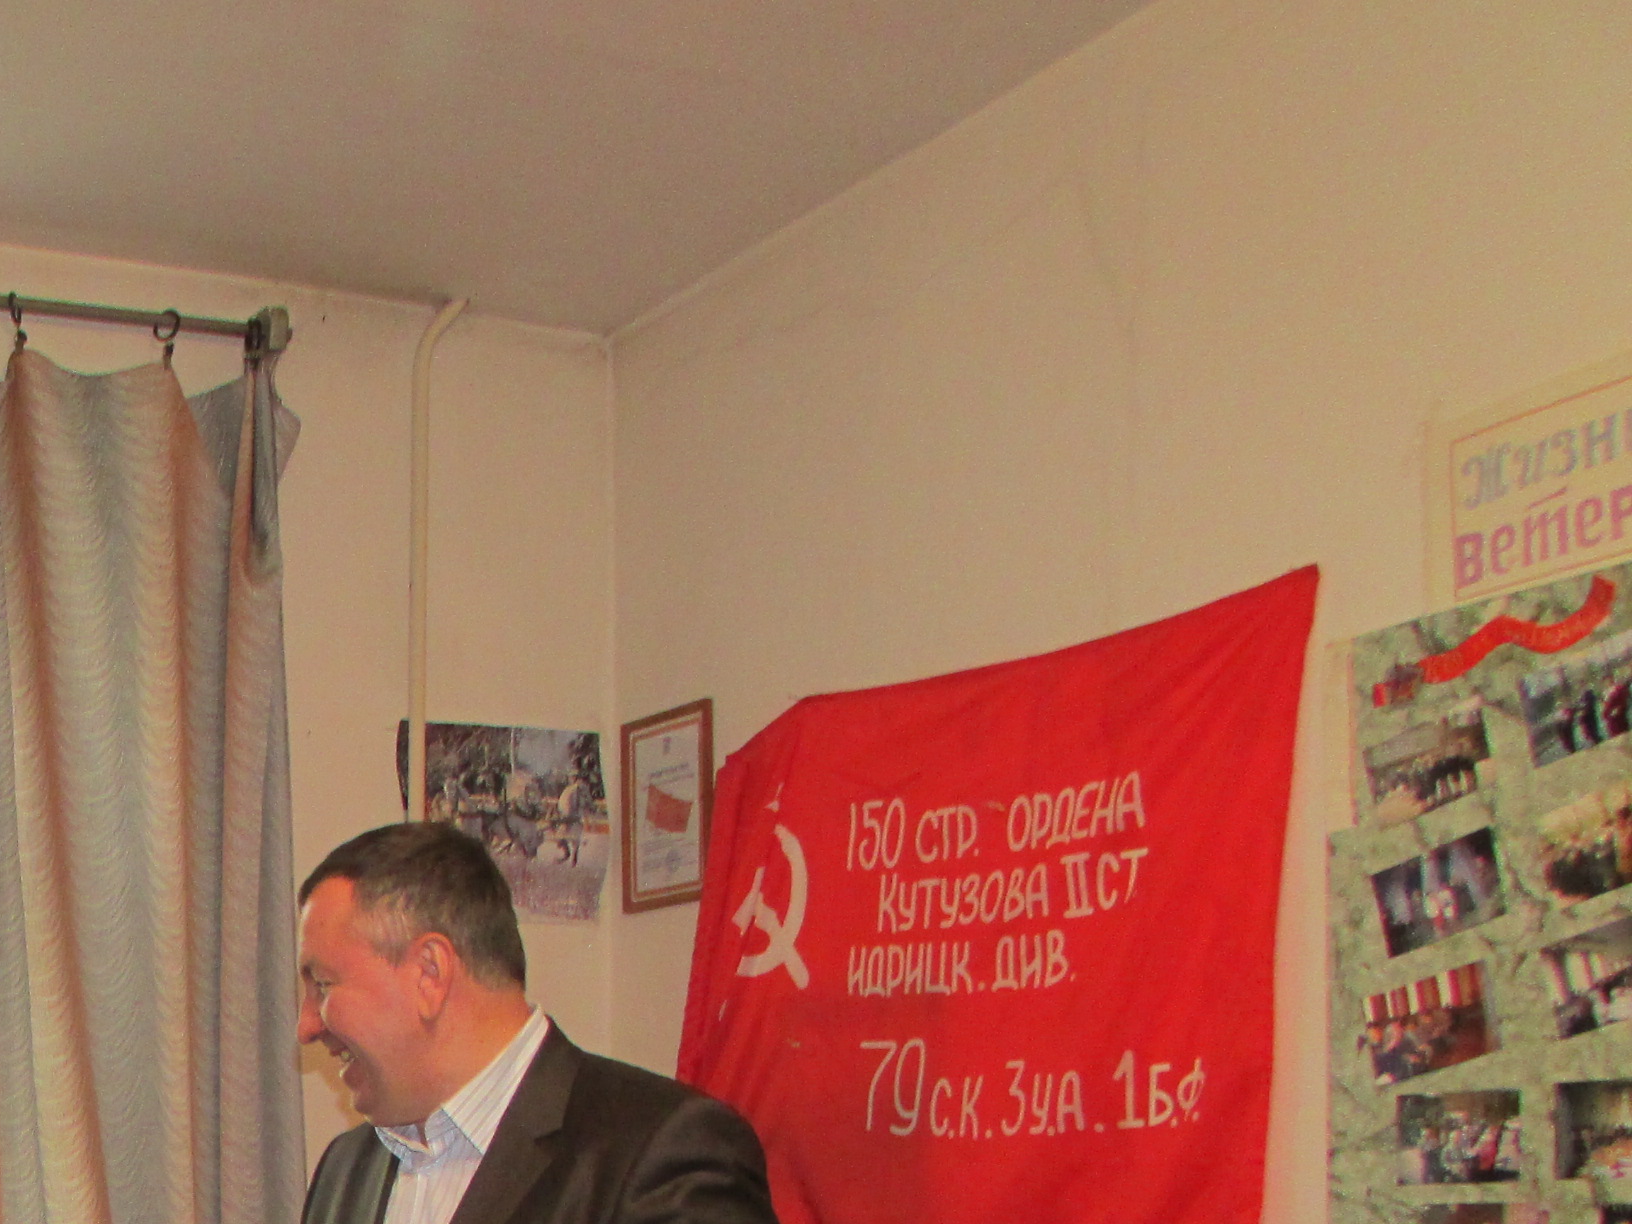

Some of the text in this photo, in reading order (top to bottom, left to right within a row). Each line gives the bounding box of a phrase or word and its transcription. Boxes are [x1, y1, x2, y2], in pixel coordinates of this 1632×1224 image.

[846, 798, 906, 872] 150
[1006, 770, 1146, 853] ОРДЕНА
[877, 863, 1049, 934] КУТУЗОВА
[991, 929, 1076, 993] ДИВ.
